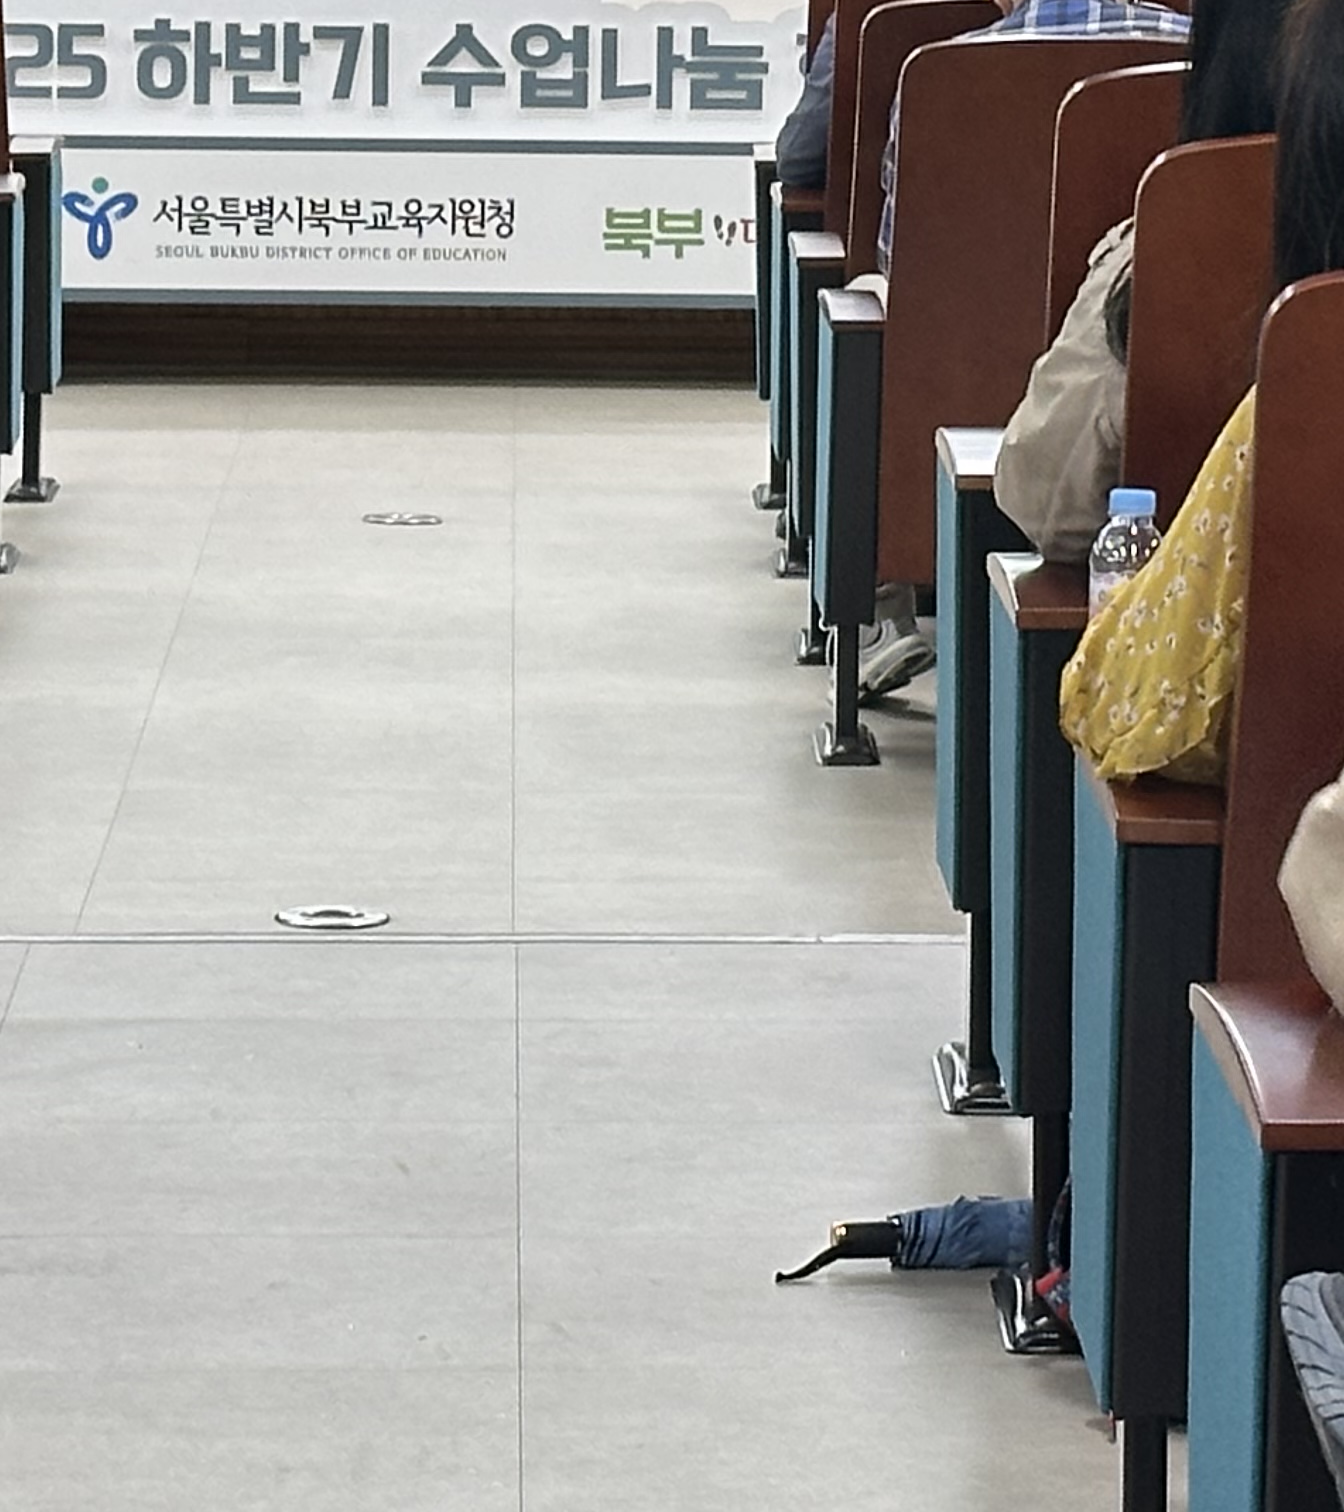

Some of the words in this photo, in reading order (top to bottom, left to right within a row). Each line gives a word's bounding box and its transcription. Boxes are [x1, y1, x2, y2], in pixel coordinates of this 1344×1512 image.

[133, 18, 391, 107] 하반기
[420, 23, 769, 110] 수업나눔
[153, 195, 516, 238] 서울특별시북부교육지원청
[602, 207, 705, 259] 북부
[155, 244, 204, 262] SEOUL
[209, 244, 260, 262] BUKBU
[265, 244, 333, 262] DISTRICT
[337, 244, 392, 262] OFFICE
[396, 244, 418, 262] OF
[422, 244, 508, 262] EDUCATION
